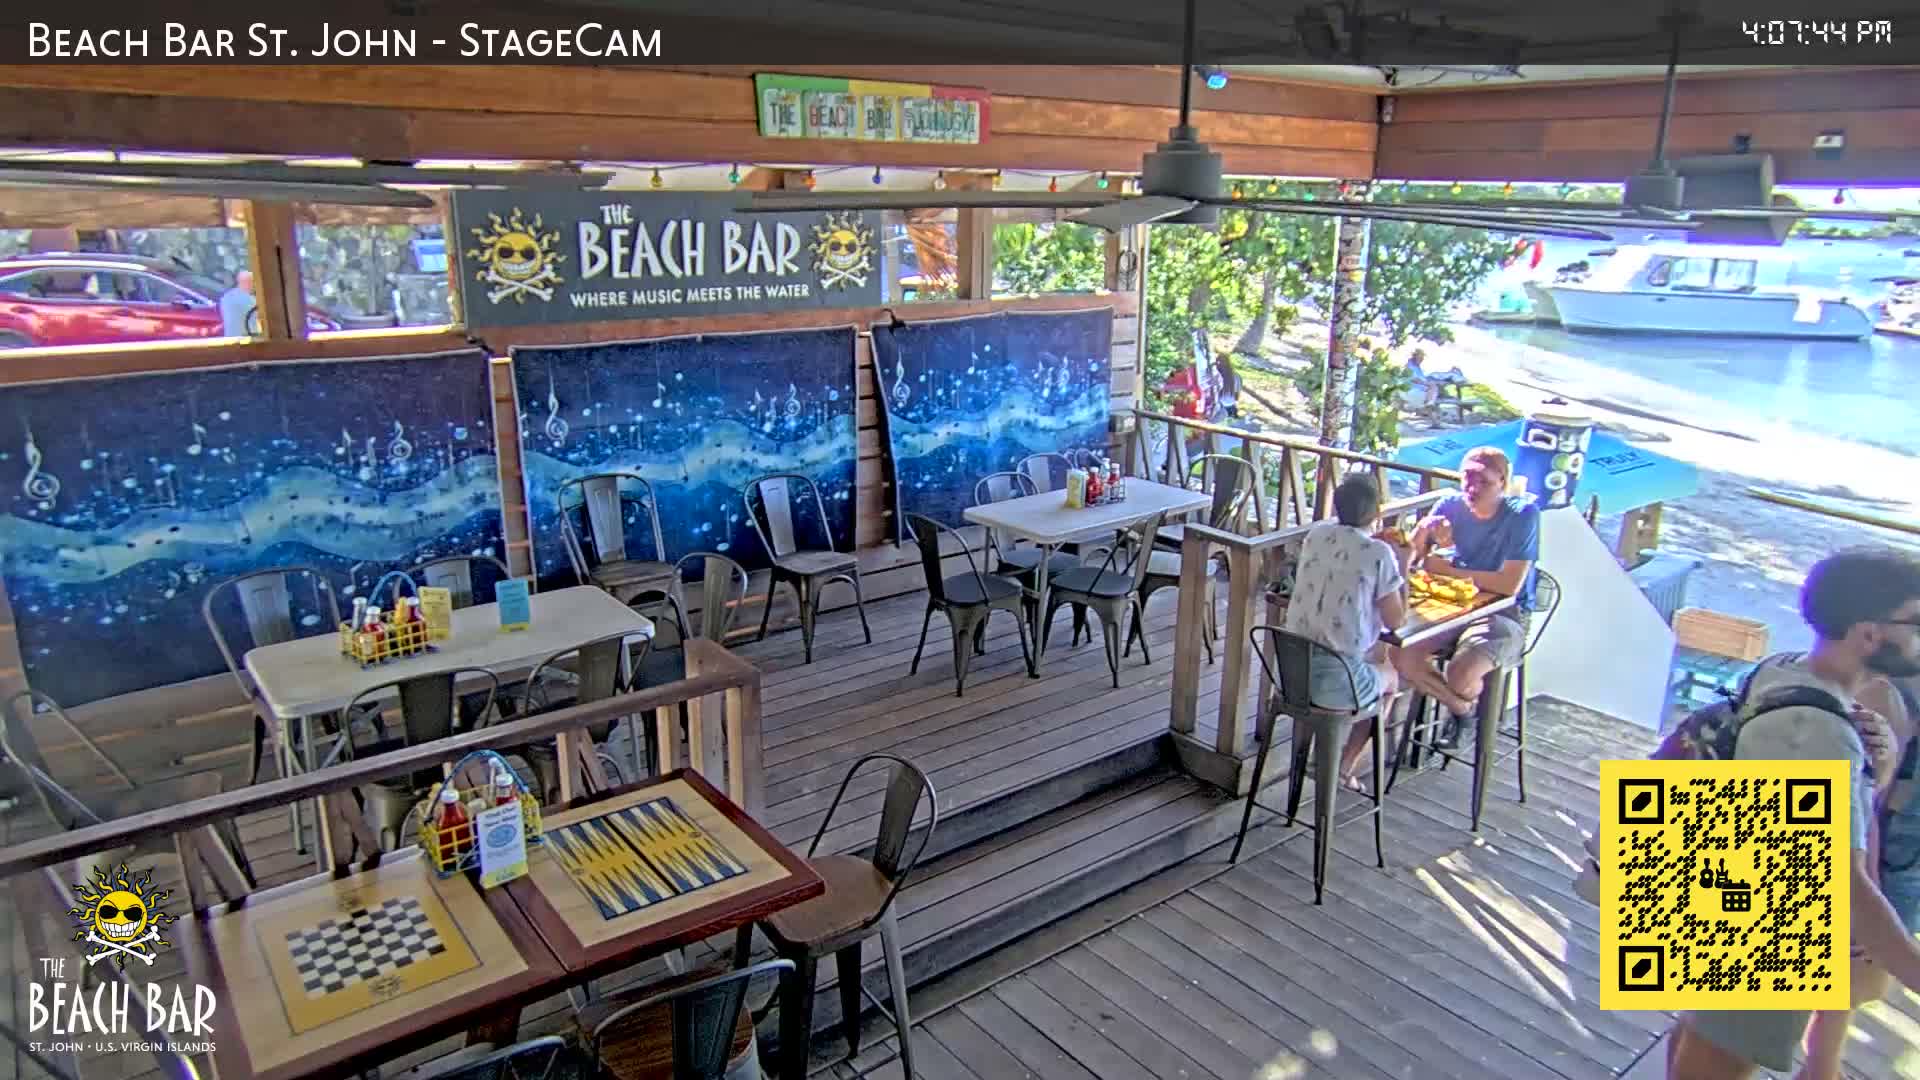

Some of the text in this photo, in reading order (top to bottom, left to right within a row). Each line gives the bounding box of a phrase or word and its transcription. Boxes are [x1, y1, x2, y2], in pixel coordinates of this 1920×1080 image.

[769, 103, 892, 130] THE BEACH BAR
[600, 204, 634, 225] THE
[579, 220, 801, 280] BEACH BAR
[570, 284, 810, 308] WHERE MUSIC MEETS THE WATER
